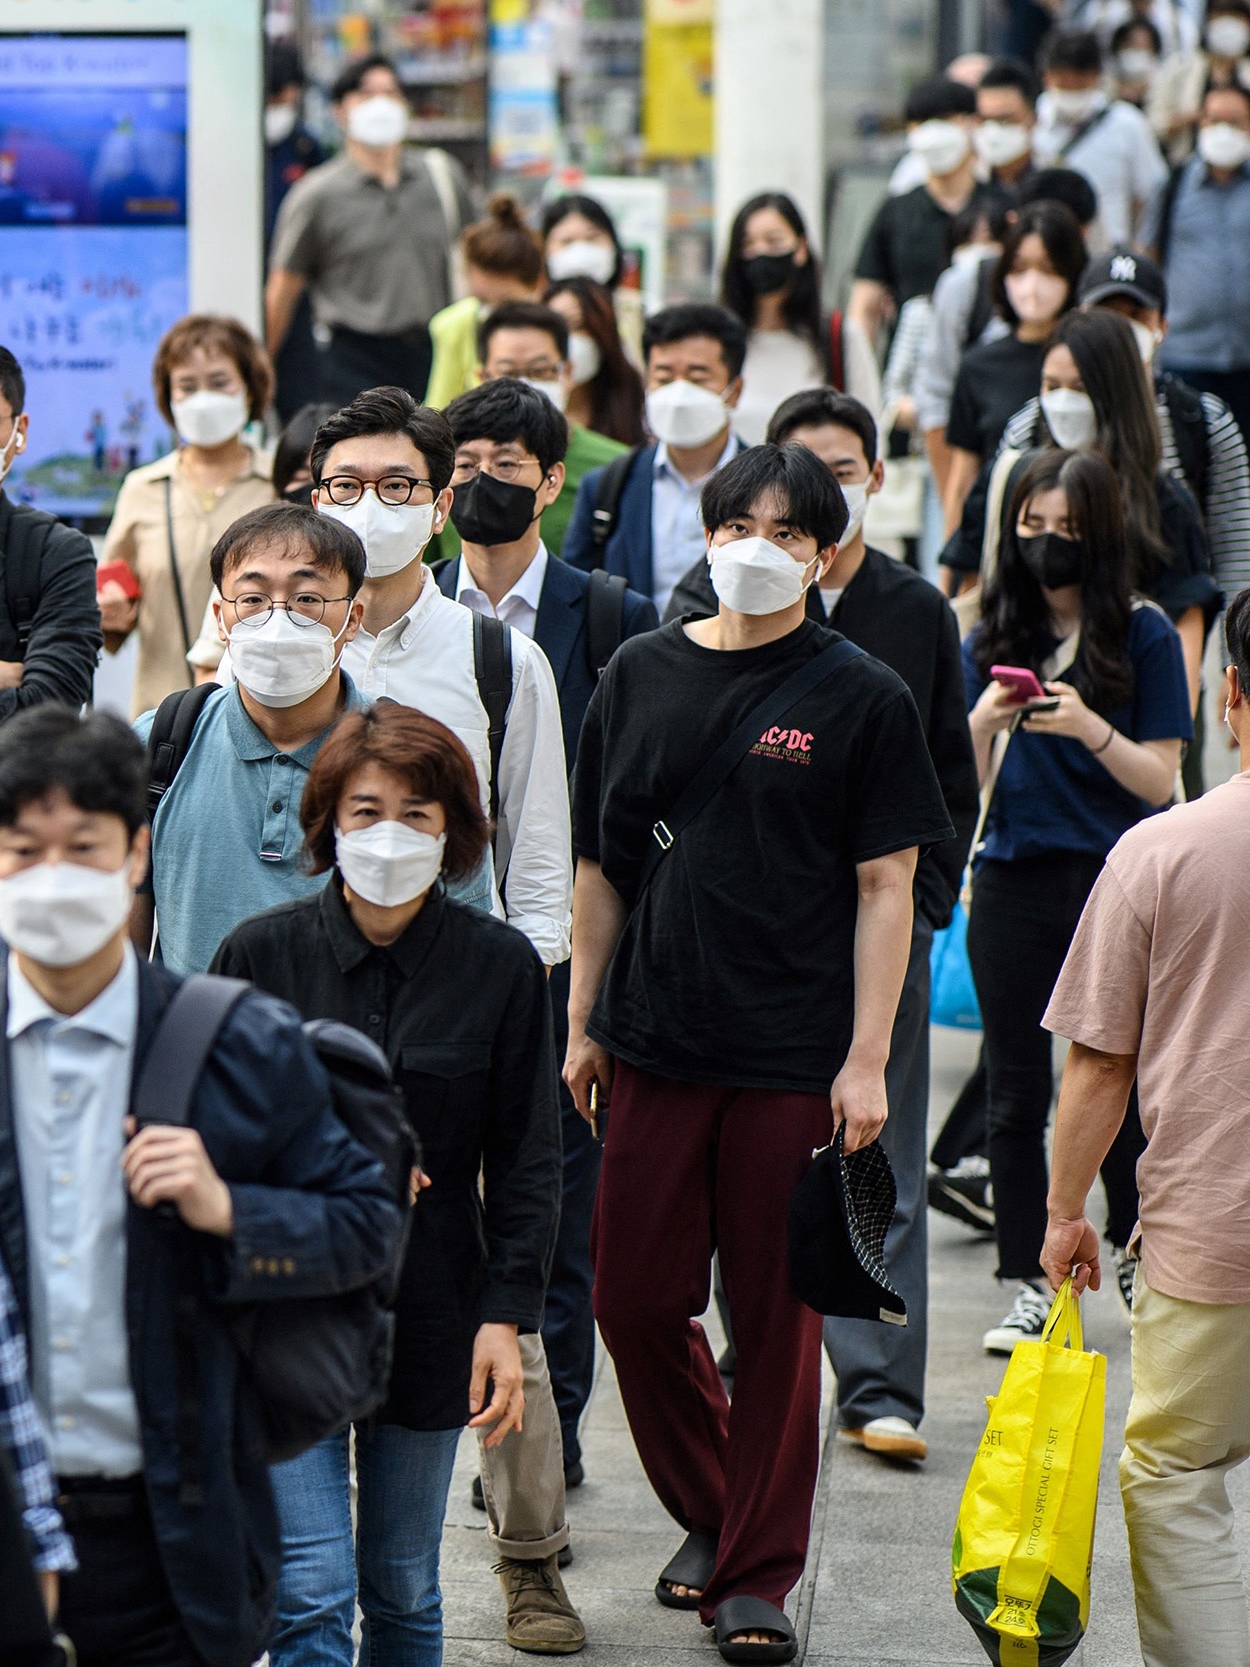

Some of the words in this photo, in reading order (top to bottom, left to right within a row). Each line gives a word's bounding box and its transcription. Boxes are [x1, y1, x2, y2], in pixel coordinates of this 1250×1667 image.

[782, 747, 792, 757] TO
[793, 749, 812, 761] HELL
[984, 1429, 1004, 1446] SET
[1047, 1426, 1059, 1446] SET
[1042, 1446, 1055, 1471] GIFT
[1035, 1473, 1051, 1515] SPECIAL
[1025, 1515, 1043, 1556] OTTOGI
